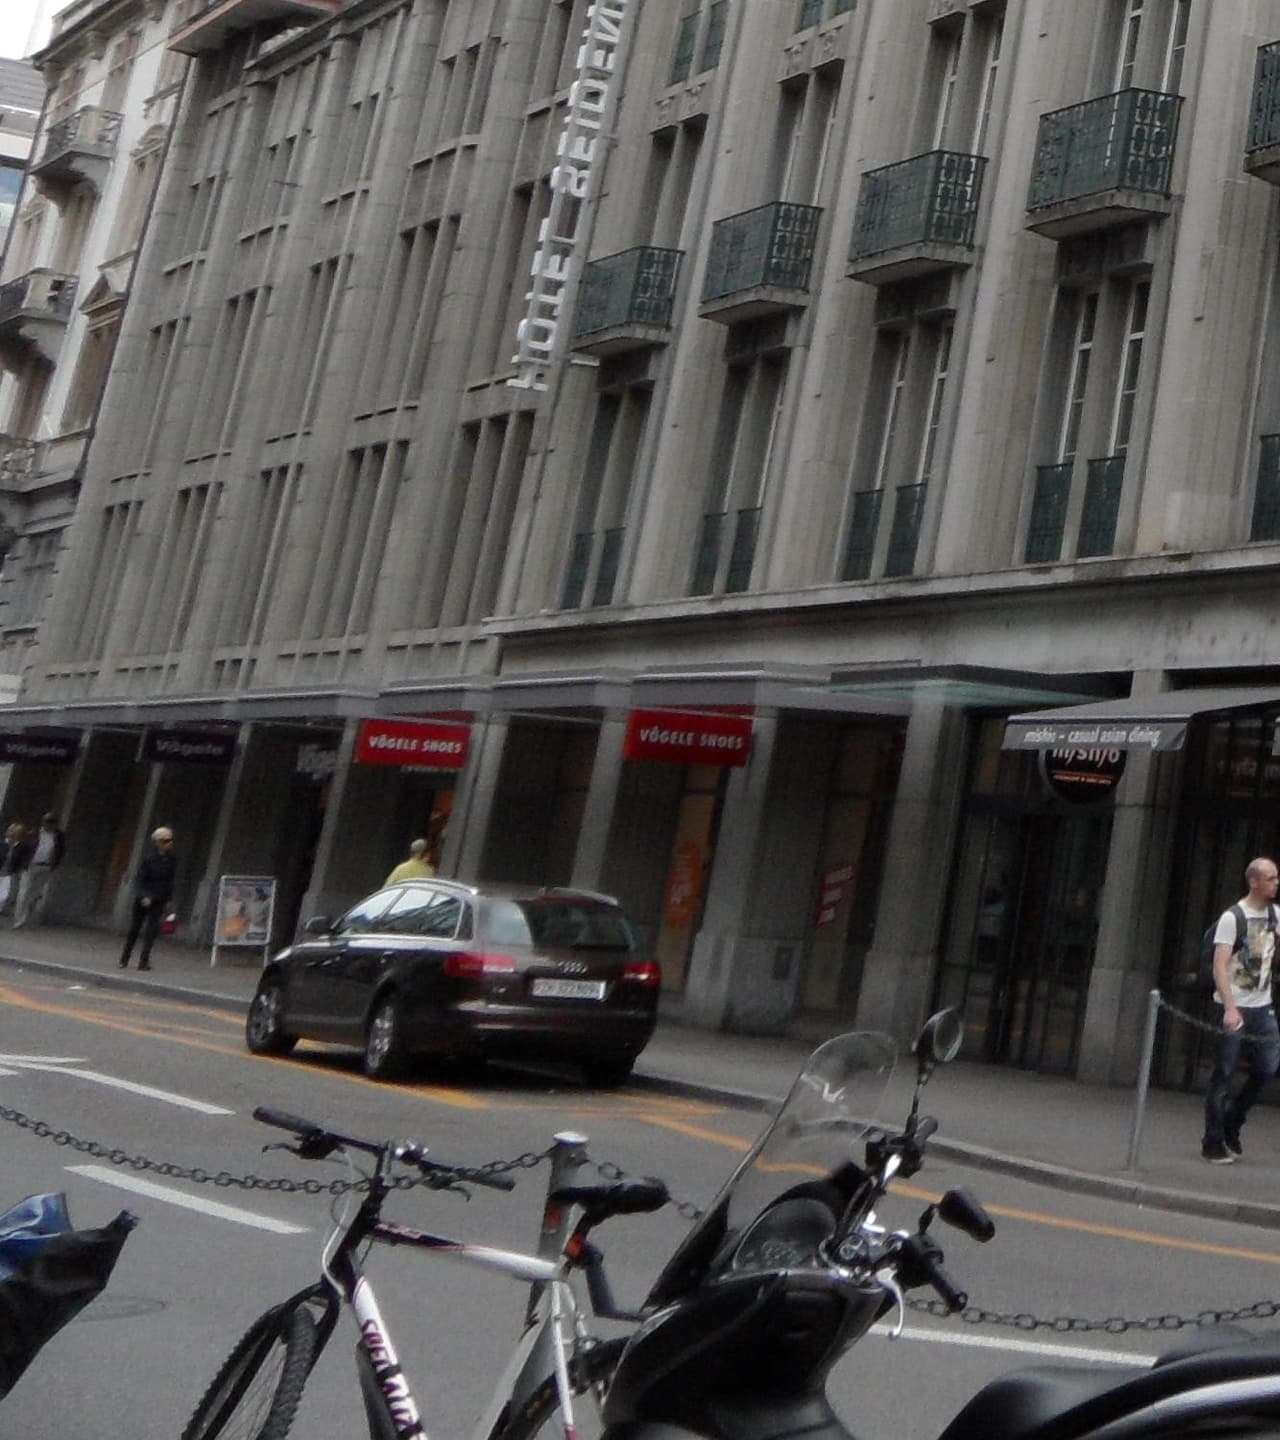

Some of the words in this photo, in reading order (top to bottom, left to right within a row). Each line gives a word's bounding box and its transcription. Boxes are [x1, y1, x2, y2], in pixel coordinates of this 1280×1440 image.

[697, 734, 745, 751] SHOES
[1068, 725, 1099, 743] casual
[1100, 727, 1126, 742] asian
[1128, 725, 1161, 748] dining
[421, 740, 464, 754] SHOES
